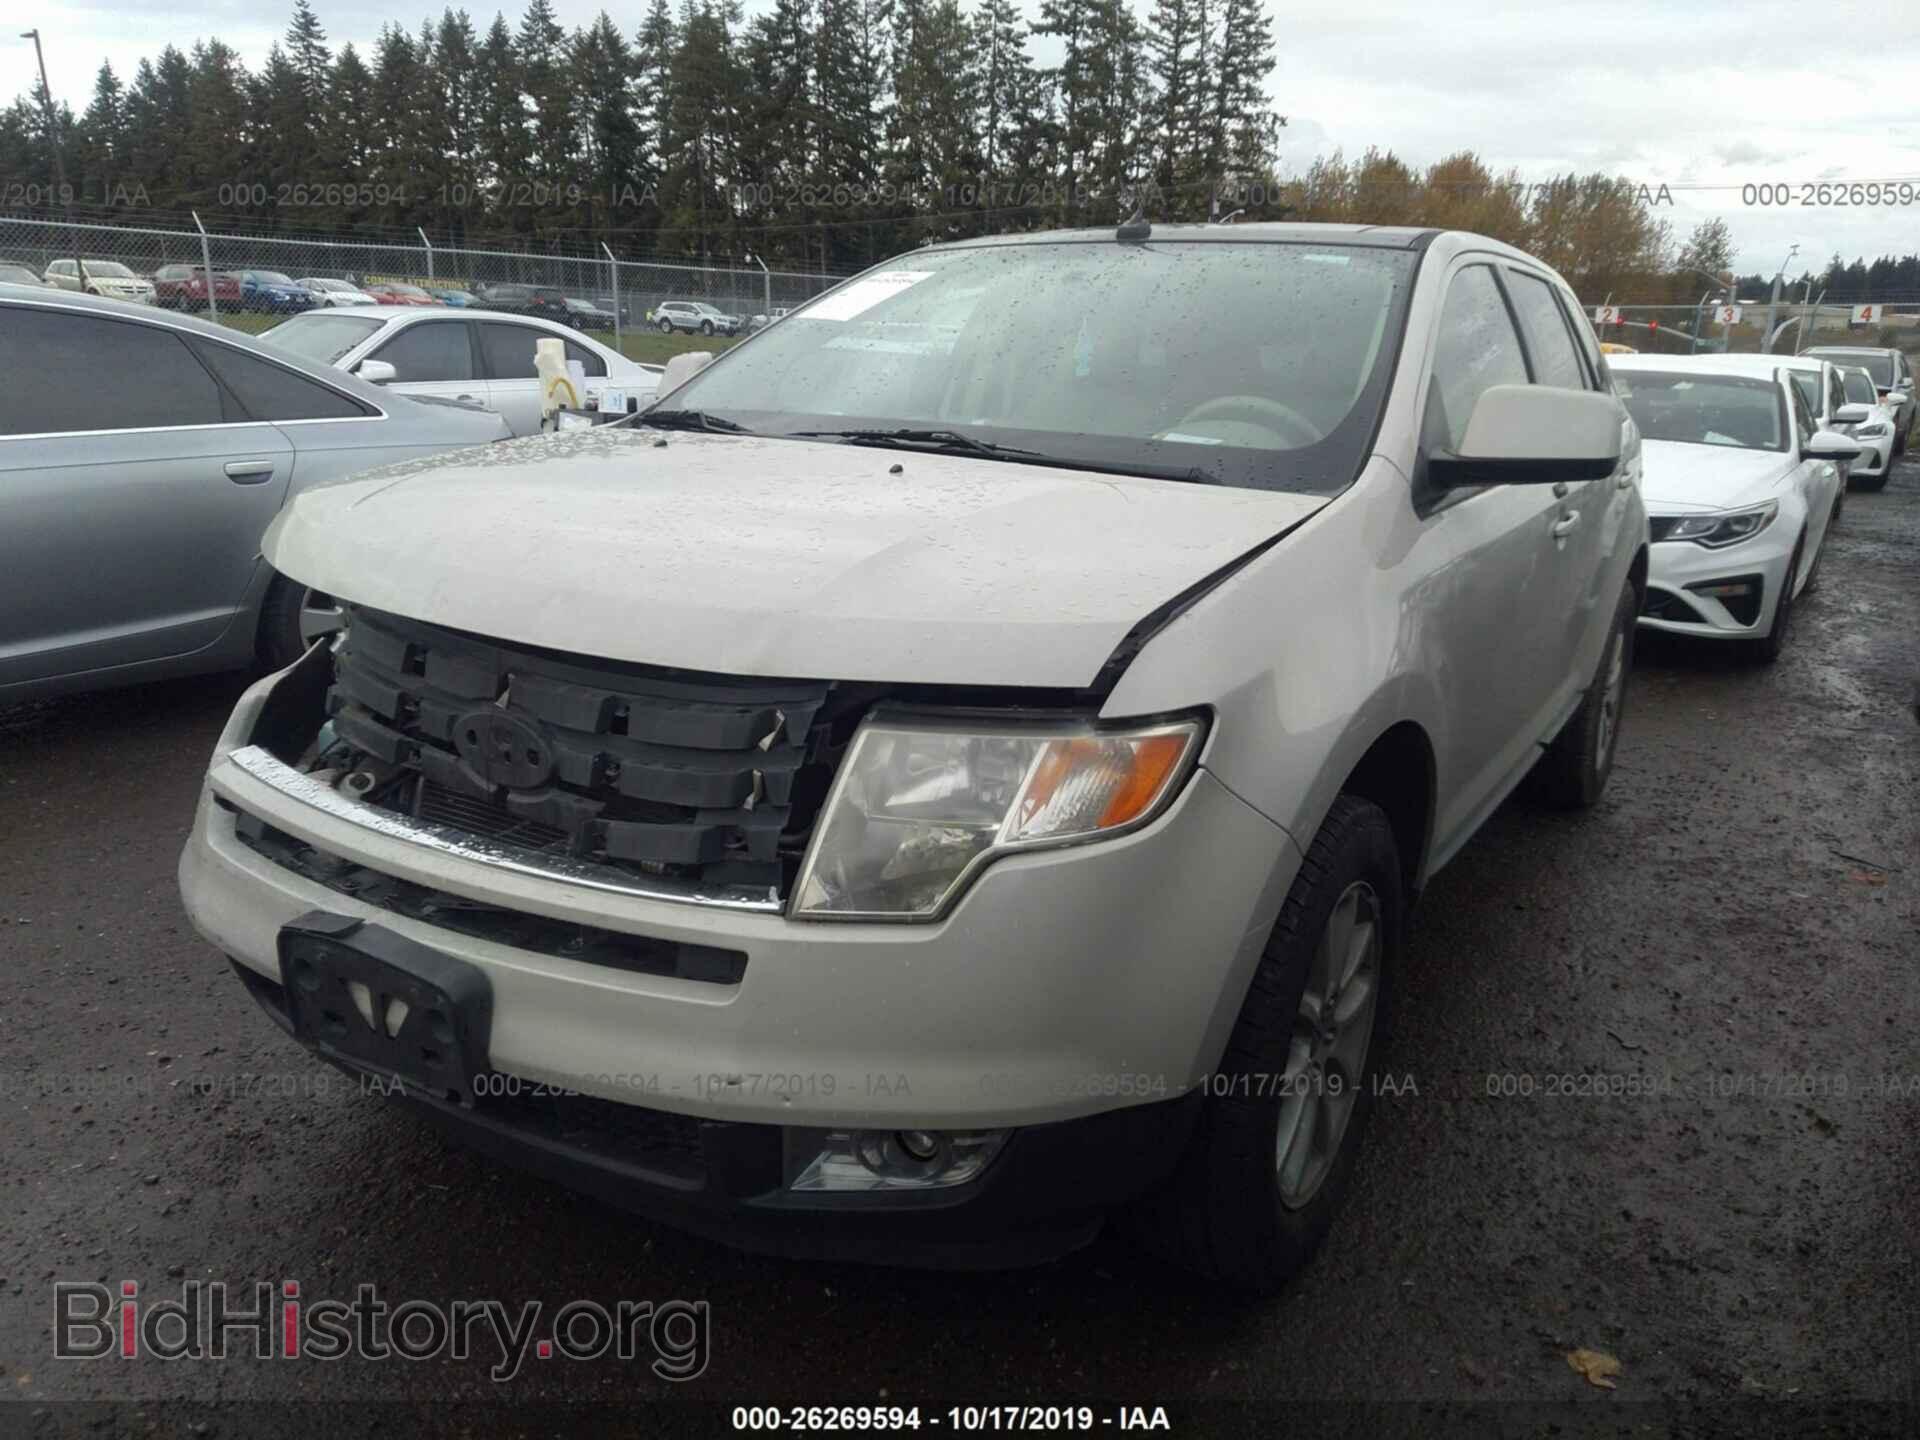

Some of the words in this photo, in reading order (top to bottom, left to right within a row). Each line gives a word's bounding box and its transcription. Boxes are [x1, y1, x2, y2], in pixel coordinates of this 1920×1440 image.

[1602, 309, 1613, 322] 2
[1723, 308, 1734, 322] 3
[1860, 307, 1873, 321] 4
